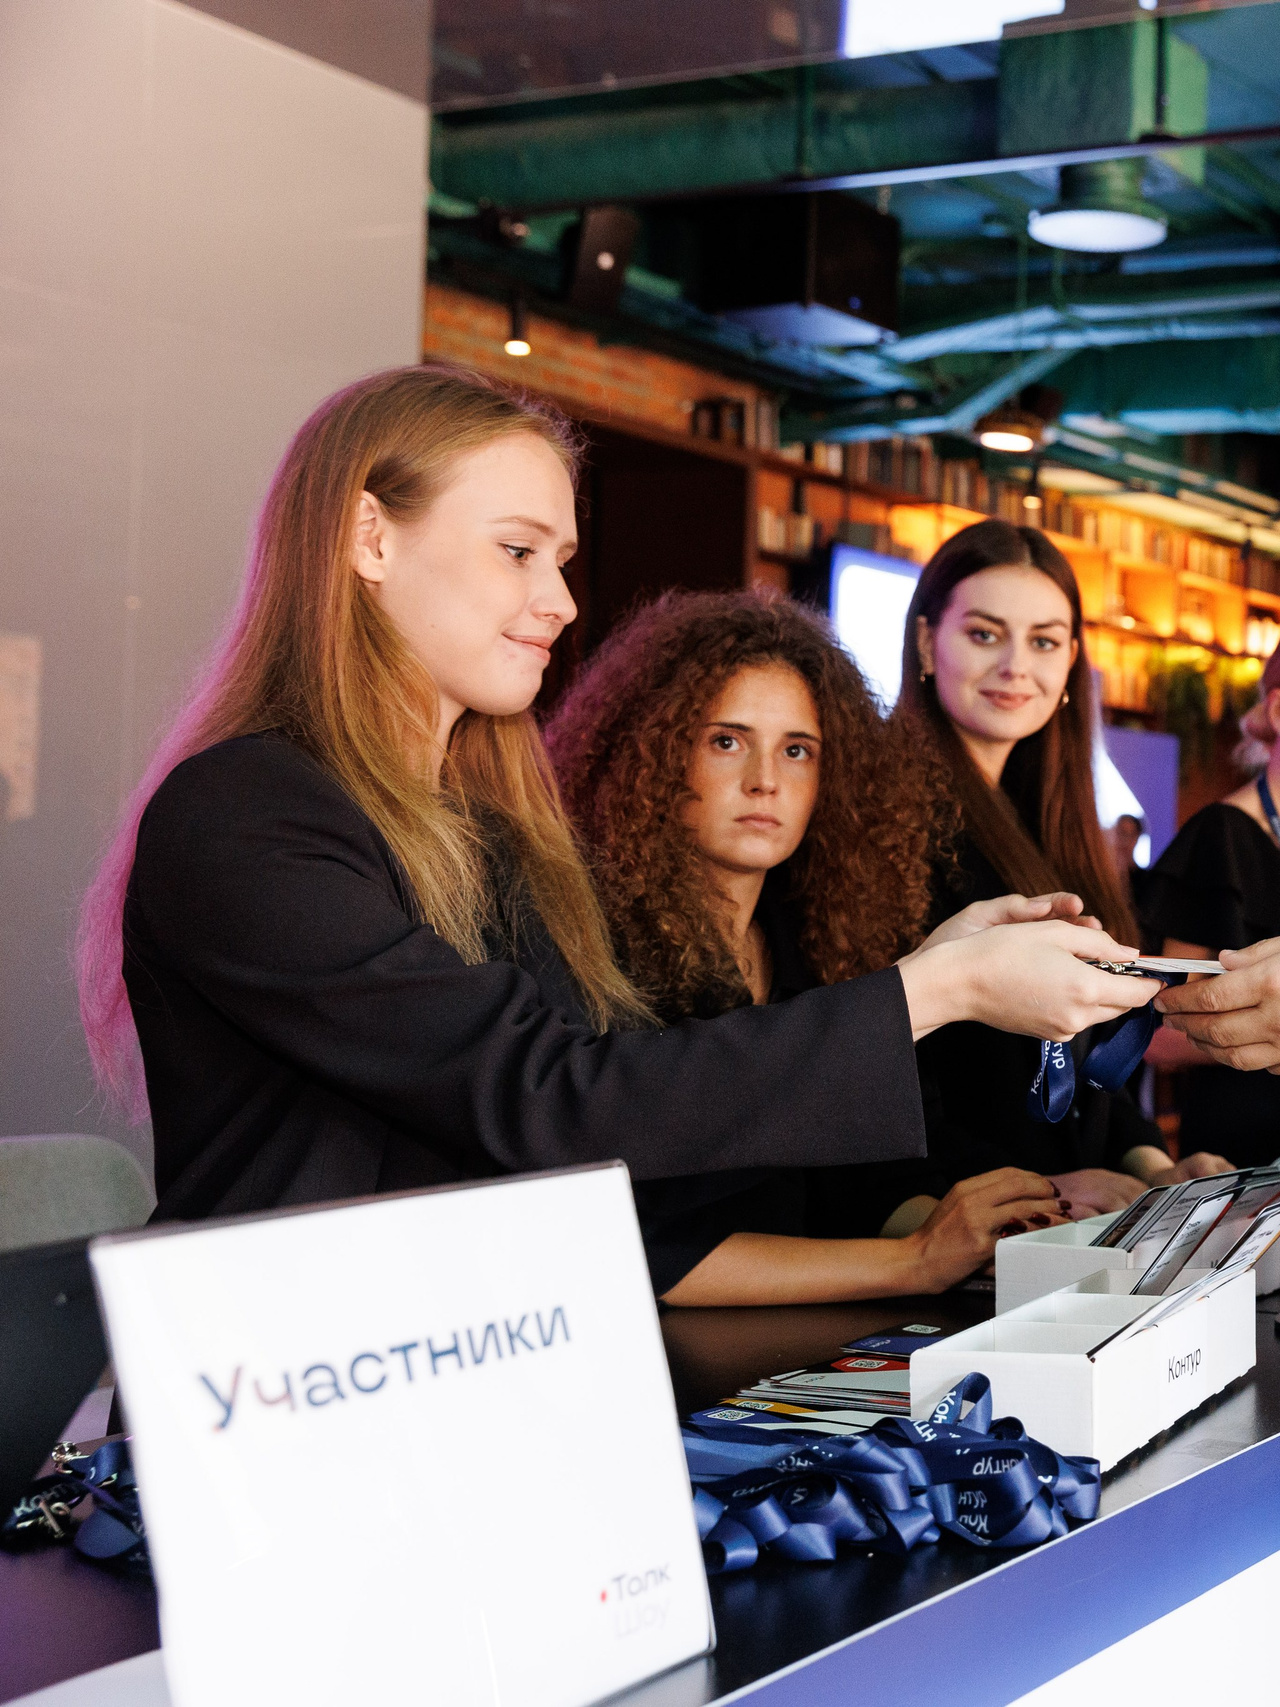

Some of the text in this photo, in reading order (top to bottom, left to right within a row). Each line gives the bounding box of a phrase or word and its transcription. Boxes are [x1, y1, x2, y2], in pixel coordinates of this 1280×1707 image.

[198, 1304, 573, 1434] Участники
[1167, 1348, 1201, 1383] Контур
[611, 1562, 671, 1602] Толк
